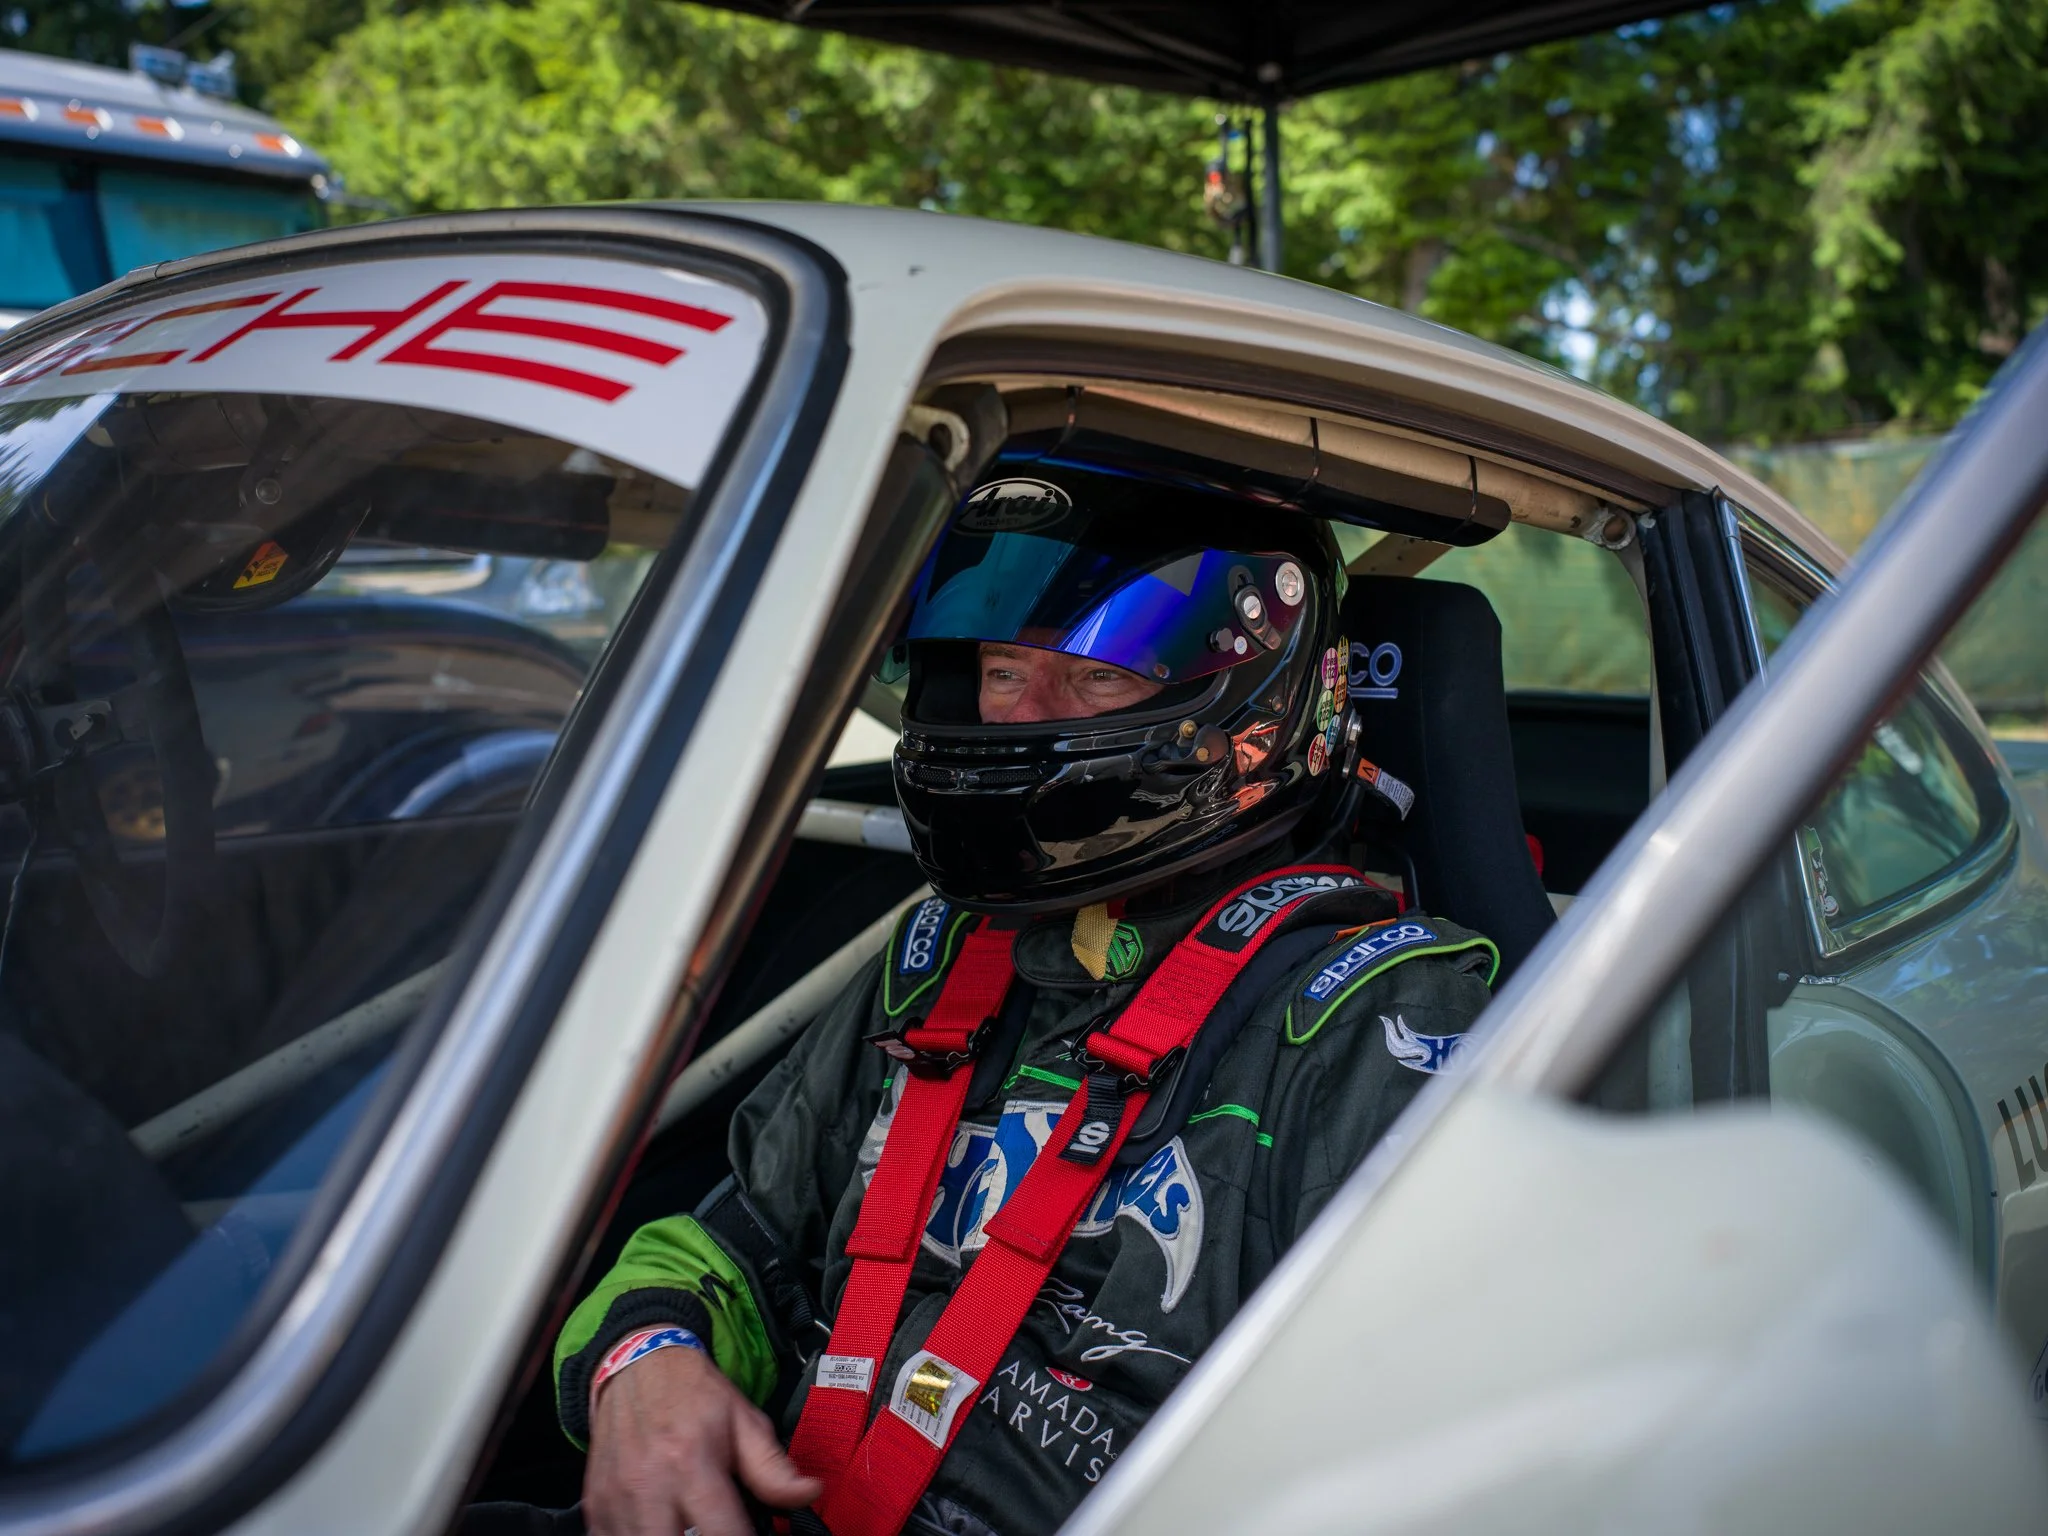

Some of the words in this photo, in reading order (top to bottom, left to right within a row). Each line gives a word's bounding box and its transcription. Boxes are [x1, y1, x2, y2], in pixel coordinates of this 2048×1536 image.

[962, 486, 1056, 517] Arai
[1310, 924, 1427, 996] sparco
[1997, 1061, 2048, 1193] LU
[997, 1359, 1114, 1456] AMADA
